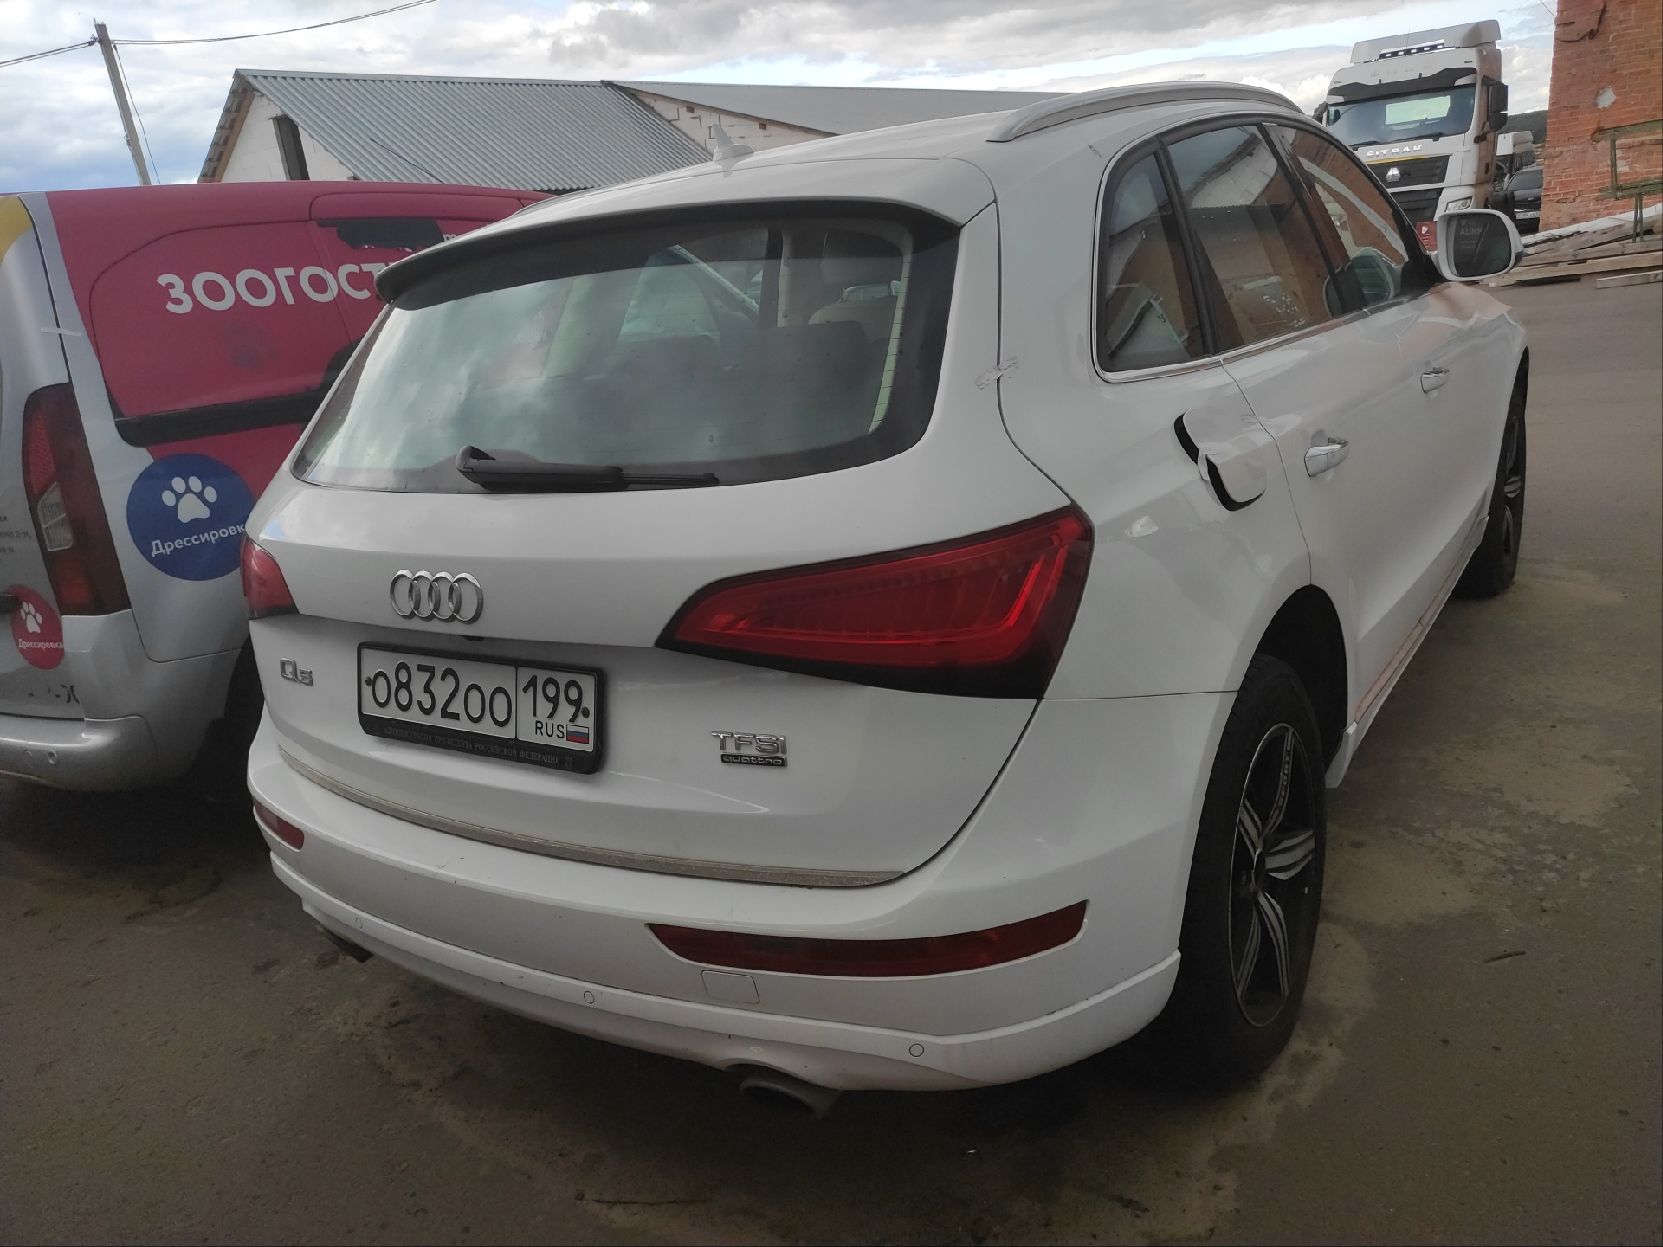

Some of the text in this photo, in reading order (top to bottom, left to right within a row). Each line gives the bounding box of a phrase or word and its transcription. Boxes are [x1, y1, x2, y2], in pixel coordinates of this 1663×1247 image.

[157, 262, 396, 314] ЗООГОСТ
[280, 658, 313, 687] Q5
[522, 674, 583, 723] 199
[534, 720, 565, 739] RUS
